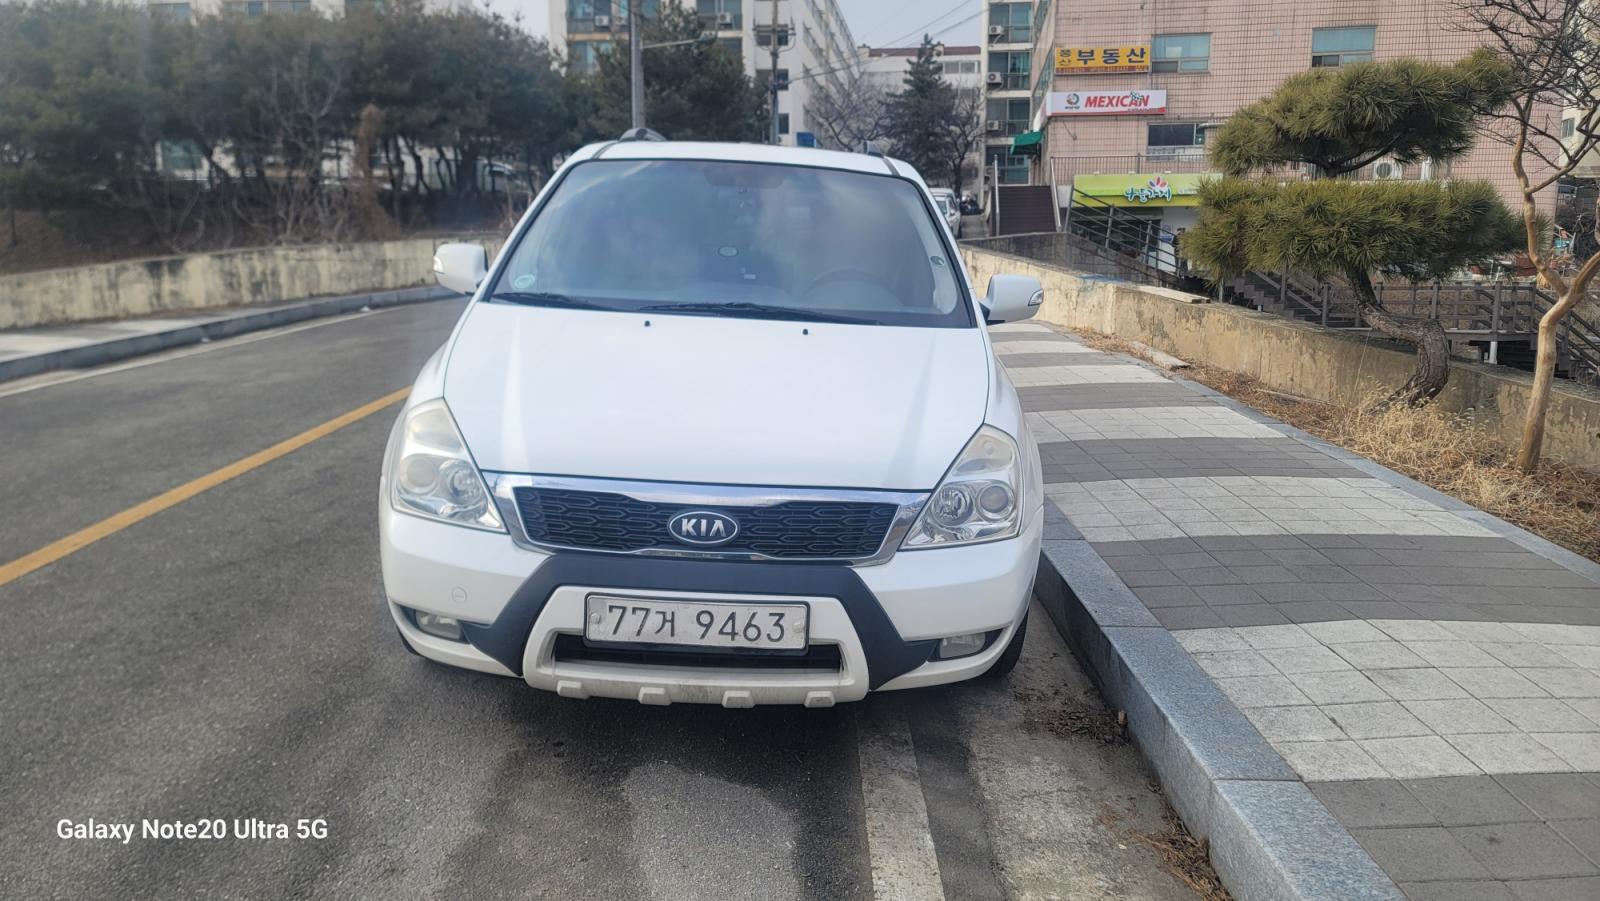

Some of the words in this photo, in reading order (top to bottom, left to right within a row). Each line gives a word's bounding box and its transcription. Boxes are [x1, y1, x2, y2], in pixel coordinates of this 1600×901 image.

[1076, 47, 1146, 65] 부동산
[1084, 94, 1150, 108] MEXICAN
[681, 518, 727, 537] KIA
[608, 605, 676, 637] 77거
[695, 610, 786, 643] 9463
